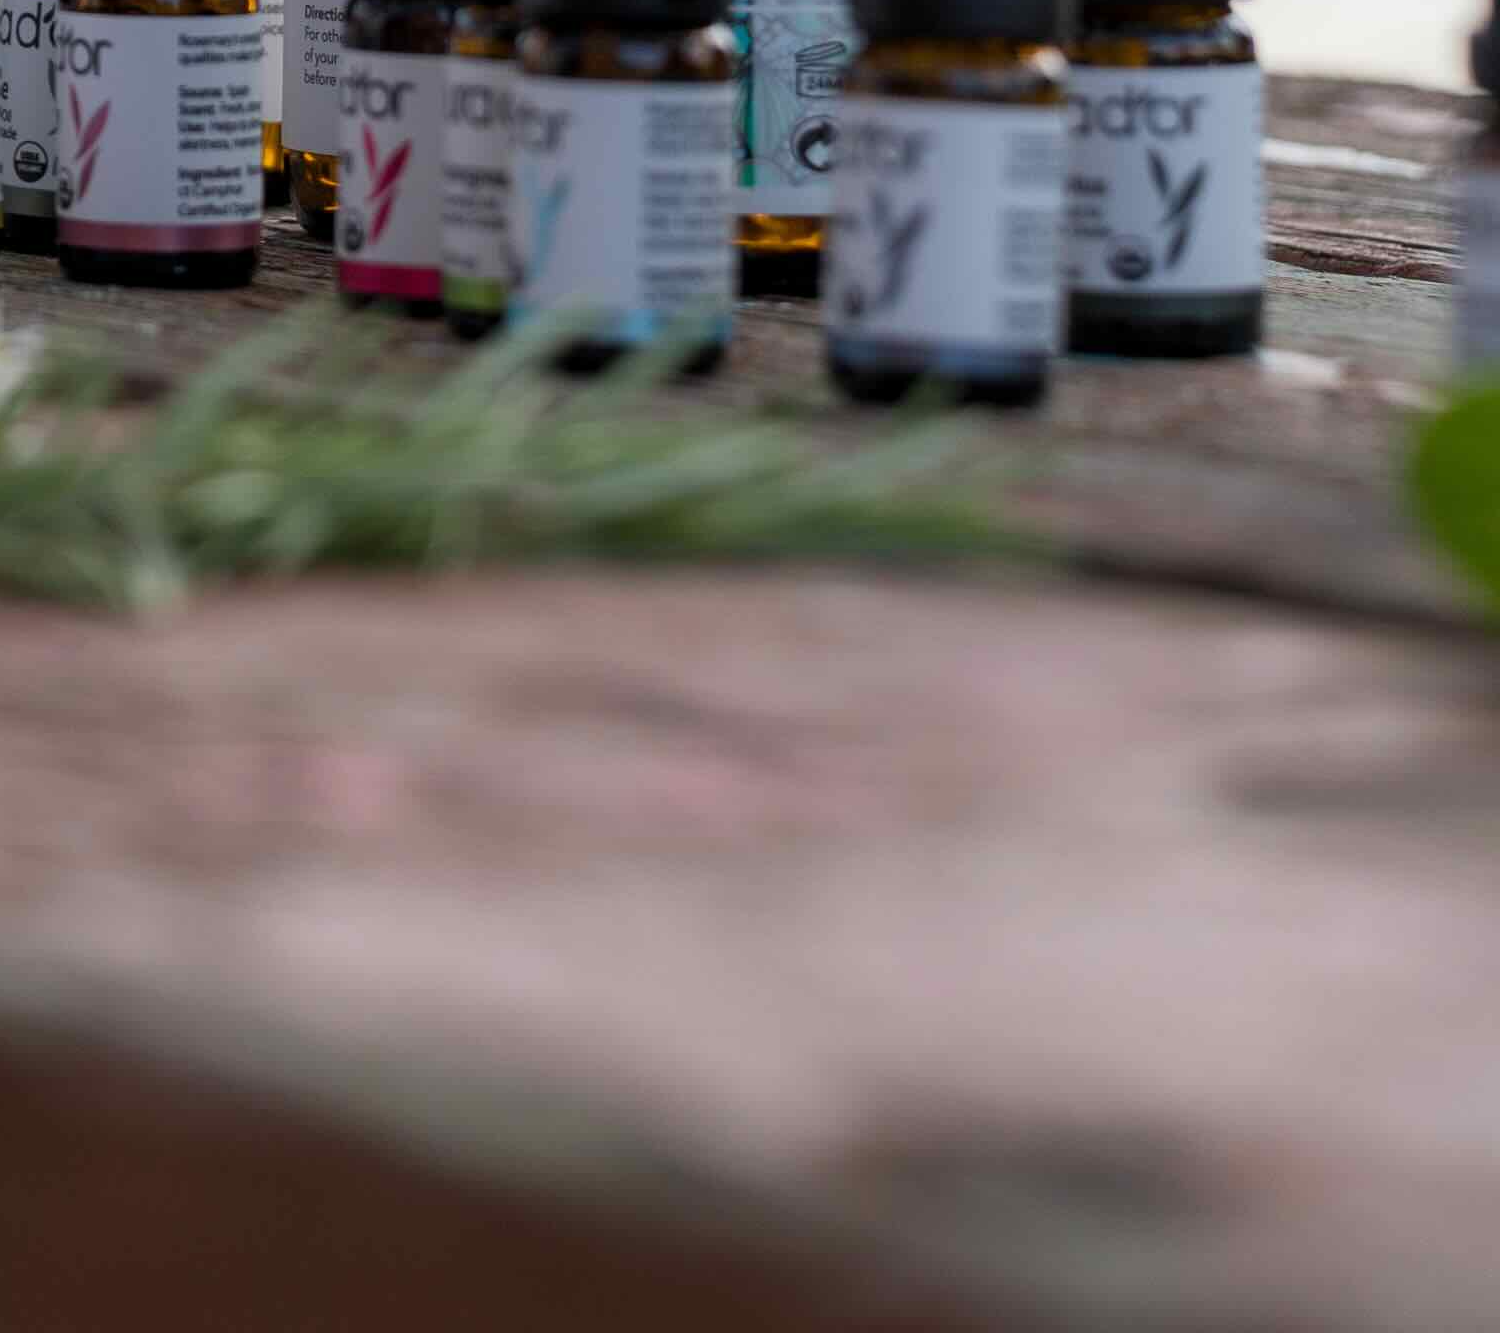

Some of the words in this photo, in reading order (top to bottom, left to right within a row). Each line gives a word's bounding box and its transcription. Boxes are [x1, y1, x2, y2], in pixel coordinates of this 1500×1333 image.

[304, 25, 319, 40] For
[304, 46, 314, 62] of
[315, 51, 340, 68] your
[303, 67, 337, 87] before
